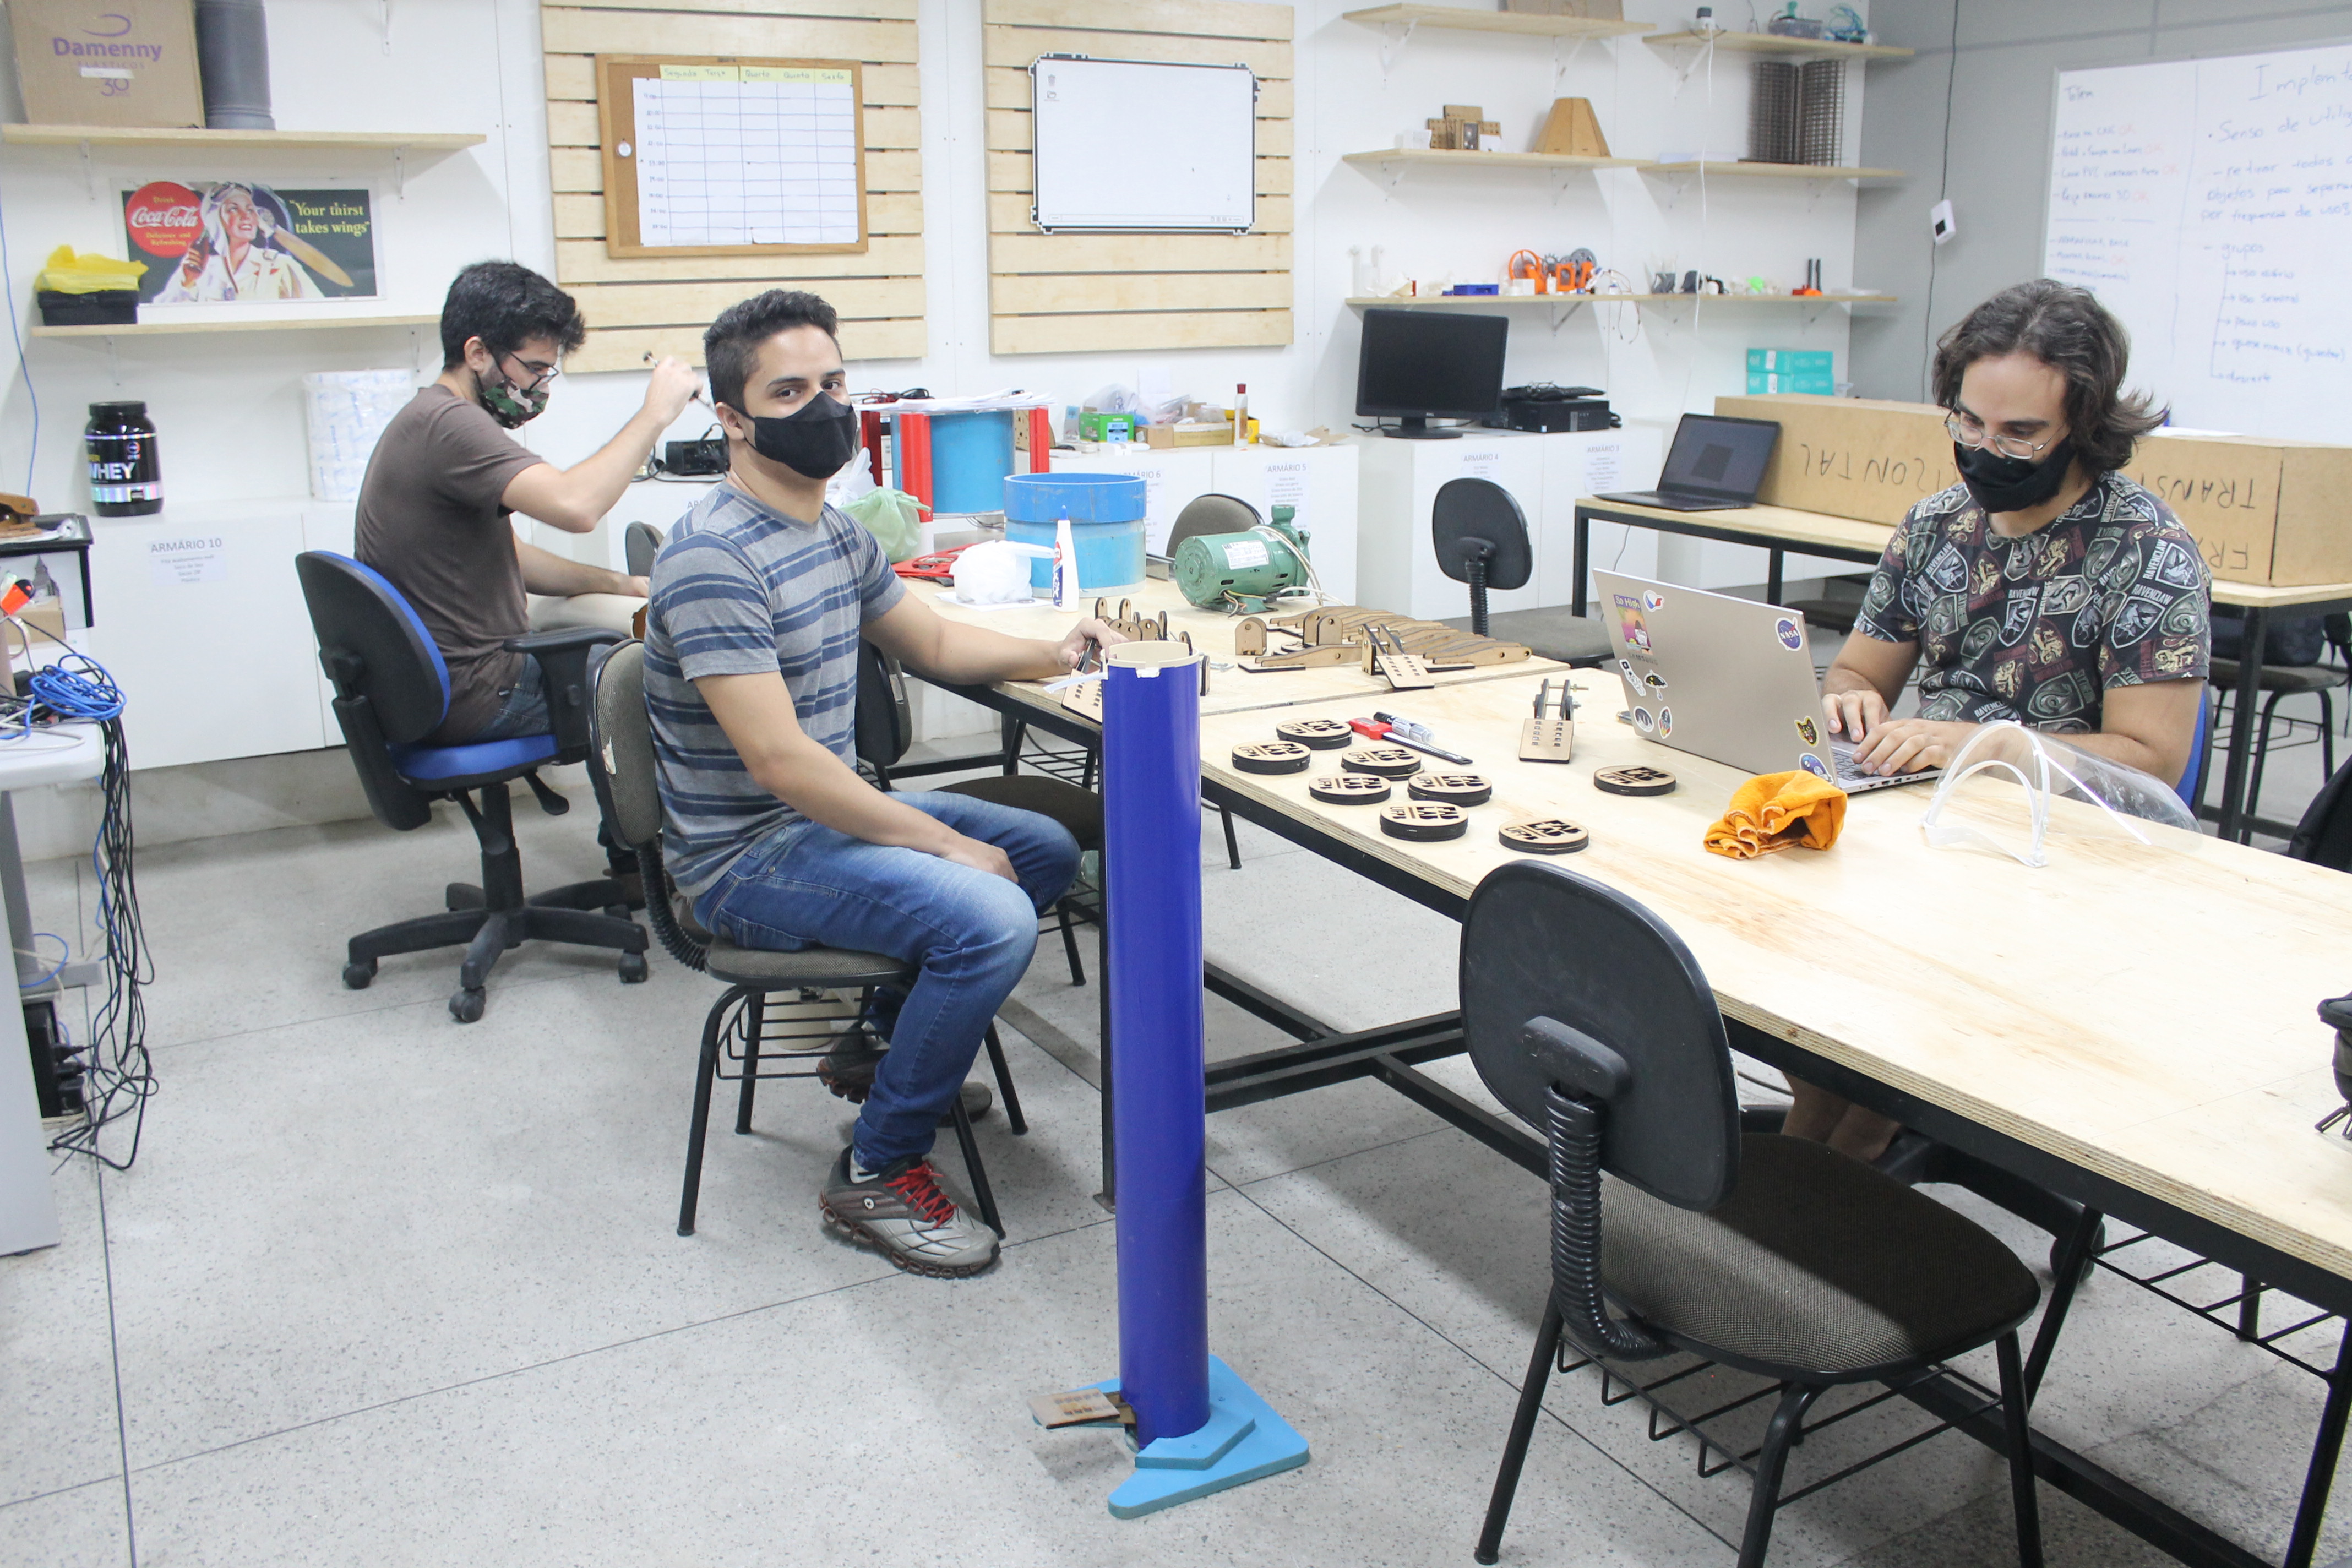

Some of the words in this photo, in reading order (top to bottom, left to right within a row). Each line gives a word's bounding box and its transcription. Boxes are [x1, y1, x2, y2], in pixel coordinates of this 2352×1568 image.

[53, 36, 162, 62] Damenny
[2278, 116, 2300, 132] de
[329, 202, 364, 216] thirst
[2295, 204, 2312, 218] de
[131, 206, 199, 228] Coca-Cola
[295, 220, 329, 234] takes
[2222, 243, 2264, 262] grupos
[1463, 453, 1494, 462] ARMÁRIO
[1267, 463, 1301, 473] ARMÁRIO
[2157, 476, 2255, 509] TRANS
[151, 539, 205, 553] ARMÁRIO
[209, 538, 222, 548] 10
[1925, 541, 1953, 575] RAVENCLAW
[2143, 539, 2168, 580] RAVENCLAW
[2132, 584, 2174, 606] RAVENCLAW
[1615, 596, 1624, 605] So
[1625, 598, 1640, 609] High
[1779, 630, 1798, 639] NASA
[1301, 721, 1330, 732] LAB
[1317, 719, 1345, 729] FAB
[1261, 745, 1286, 755] LAB
[1277, 743, 1304, 754] FAB
[1388, 749, 1415, 760] FAB
[1370, 750, 1396, 761] LAB
[1618, 770, 1653, 781] LAB
[1635, 767, 1670, 778] FAB
[1342, 778, 1363, 789] LAB
[1362, 777, 1382, 788] FAB
[1441, 776, 1464, 787] LAB
[1461, 775, 1485, 786] FAB
[1416, 807, 1439, 820] LAB
[1436, 807, 1460, 819] FAB
[1526, 823, 1564, 837] LAB
[1544, 820, 1582, 834] FAB
